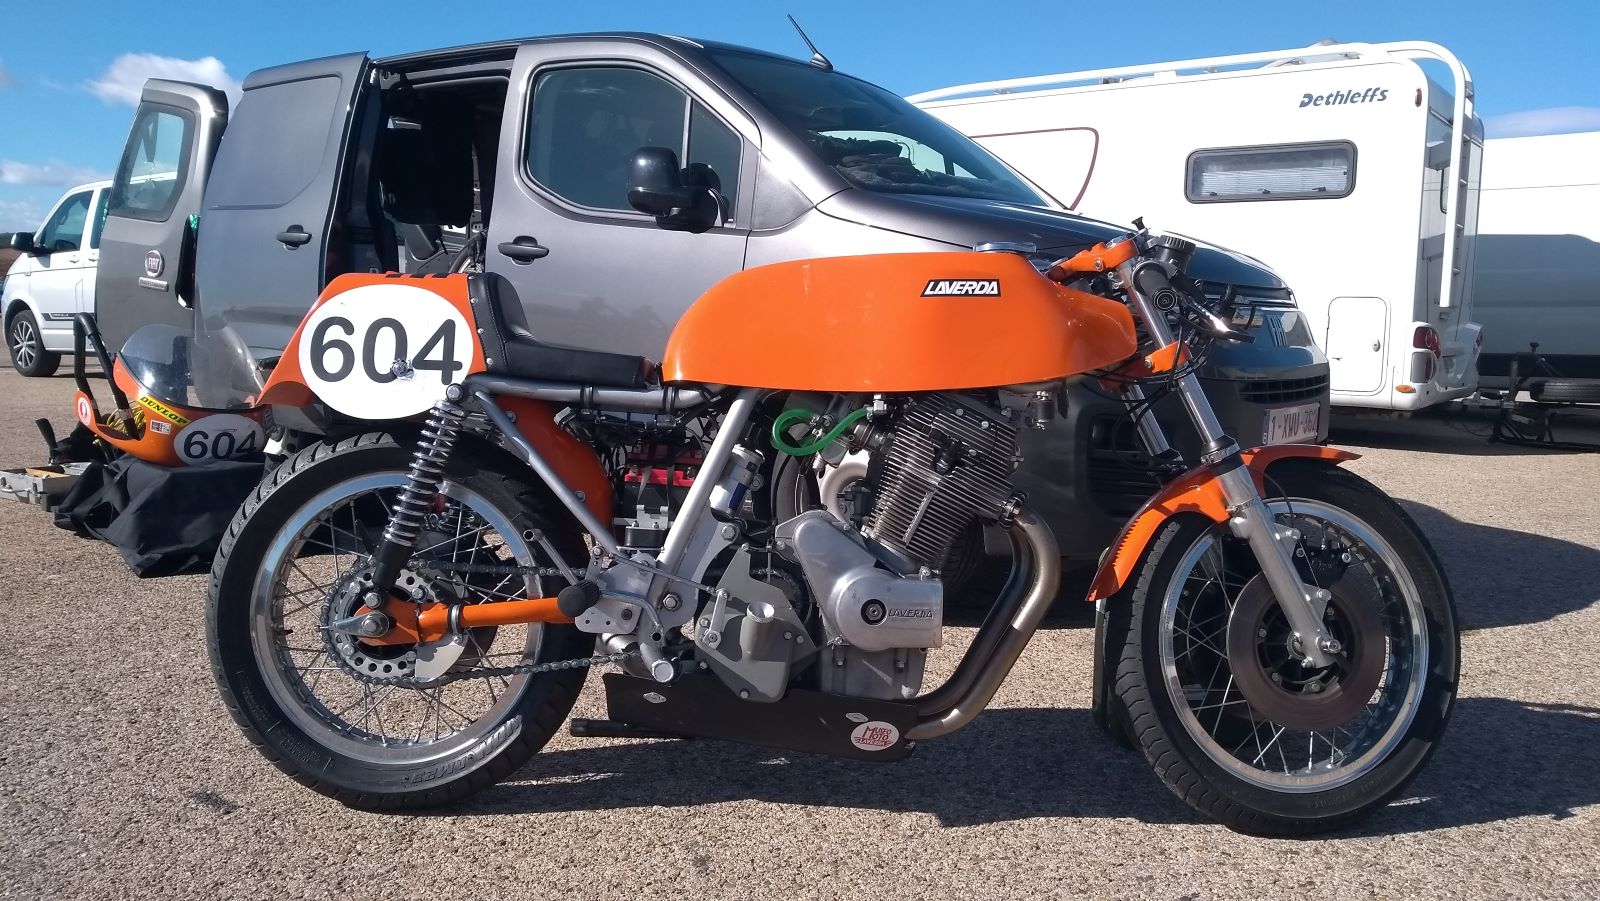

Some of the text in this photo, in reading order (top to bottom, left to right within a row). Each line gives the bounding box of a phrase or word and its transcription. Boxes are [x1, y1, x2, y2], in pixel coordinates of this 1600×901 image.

[1299, 87, 1389, 108] Dethleffs
[924, 281, 999, 295] LAVERDA
[310, 316, 463, 386] 604
[140, 396, 188, 424] DUNLOP
[183, 430, 257, 460] 604
